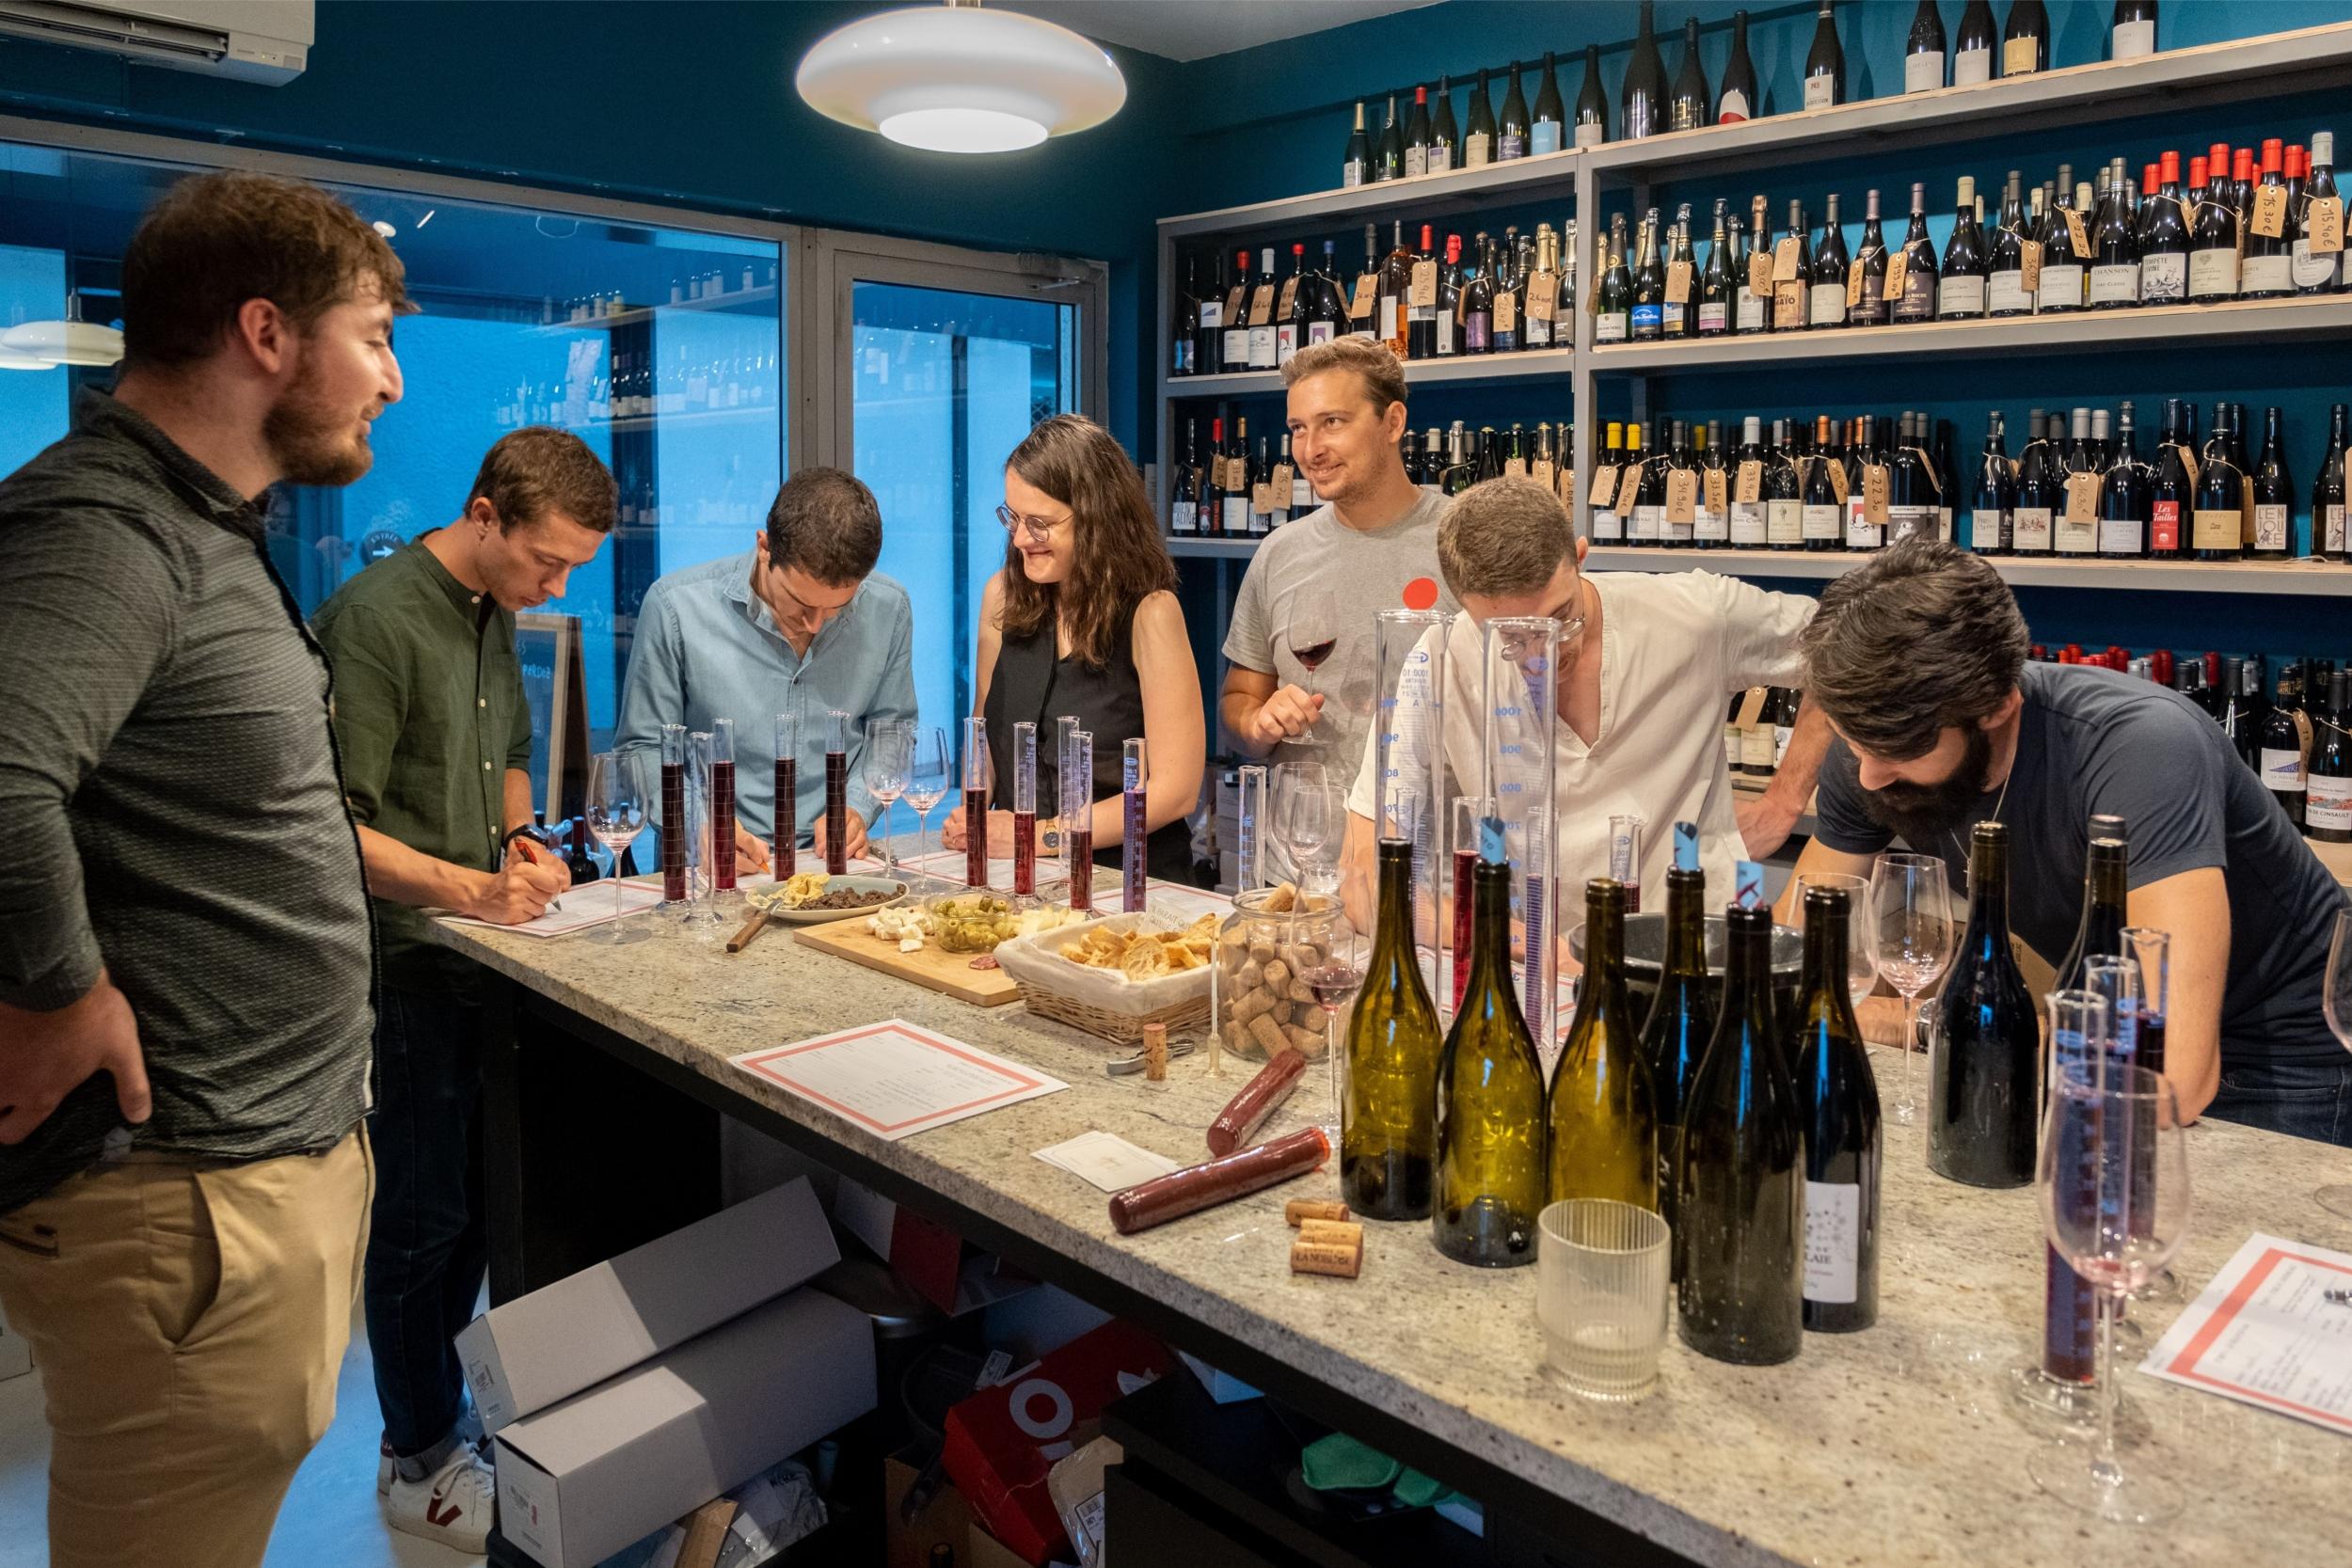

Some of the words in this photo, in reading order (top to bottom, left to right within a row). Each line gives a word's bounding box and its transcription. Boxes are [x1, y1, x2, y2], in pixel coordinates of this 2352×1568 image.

[2262, 197, 2277, 233] 15.30€
[2157, 503, 2170, 513] Les
[2153, 514, 2178, 522] Tailles
[2319, 809, 2350, 818] CINSAULT
